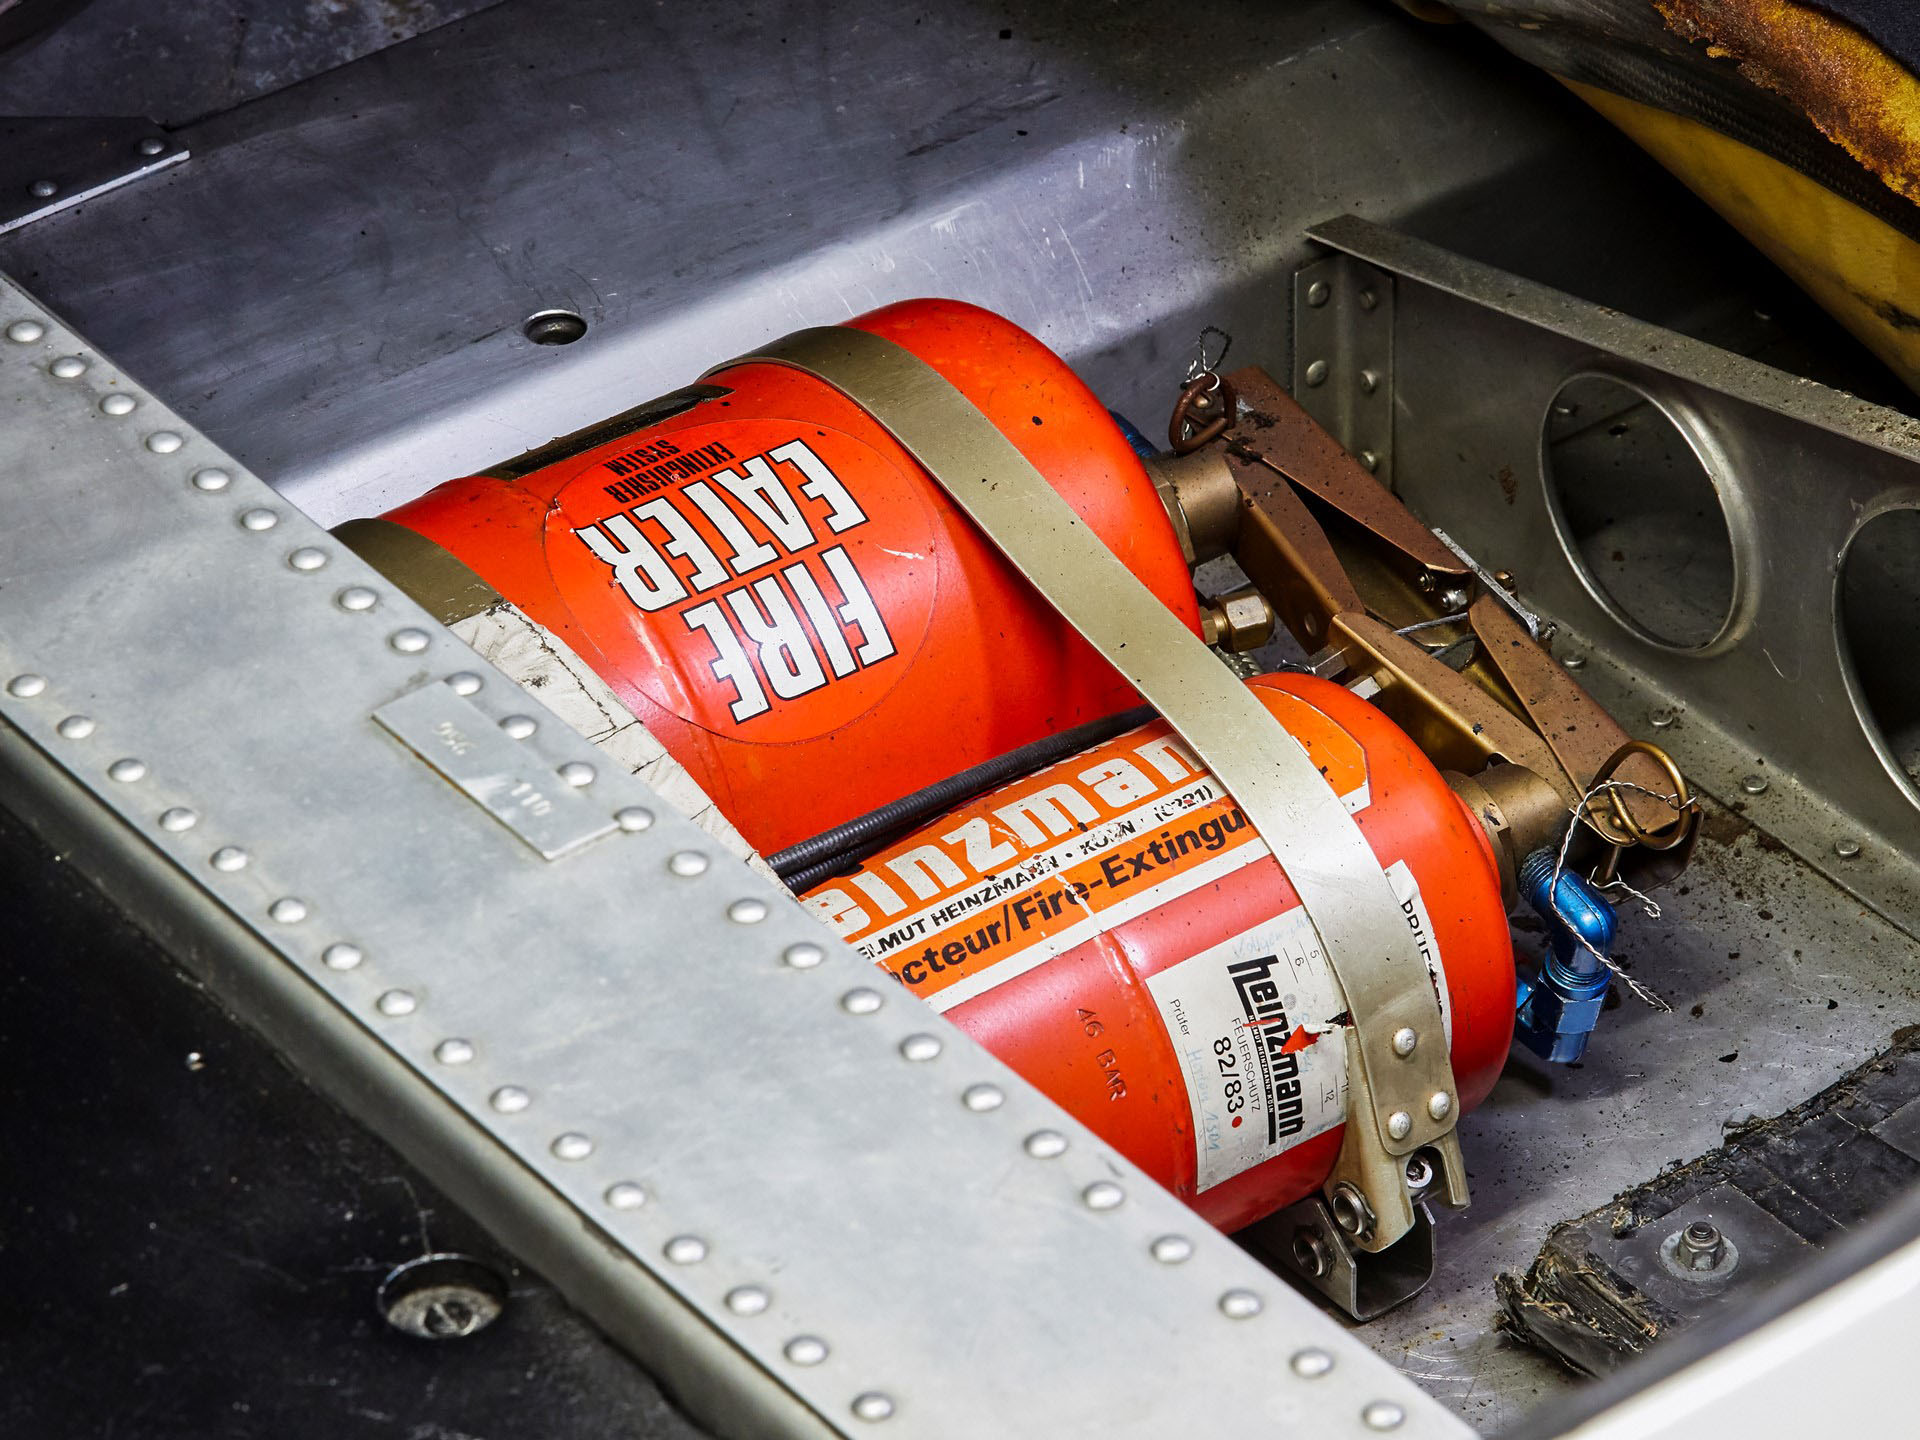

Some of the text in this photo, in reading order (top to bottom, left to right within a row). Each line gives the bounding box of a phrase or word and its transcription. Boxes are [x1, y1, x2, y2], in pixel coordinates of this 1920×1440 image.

[603, 439, 680, 476] SYSTEM
[603, 441, 736, 503] EXTINGUISHER
[575, 438, 869, 613] EATER
[680, 544, 898, 725] FIRE
[931, 855, 1060, 927] HEINZMANN
[1295, 957, 1304, 967] 6
[1309, 949, 1319, 959] 5
[1077, 1008, 1126, 1101] 46 BAR
[1170, 999, 1190, 1036] Prüfer
[1227, 955, 1304, 1139] heinzmann
[1213, 1036, 1244, 1114] 82/83
[1231, 1017, 1260, 1113] FEUERSCHUTZ
